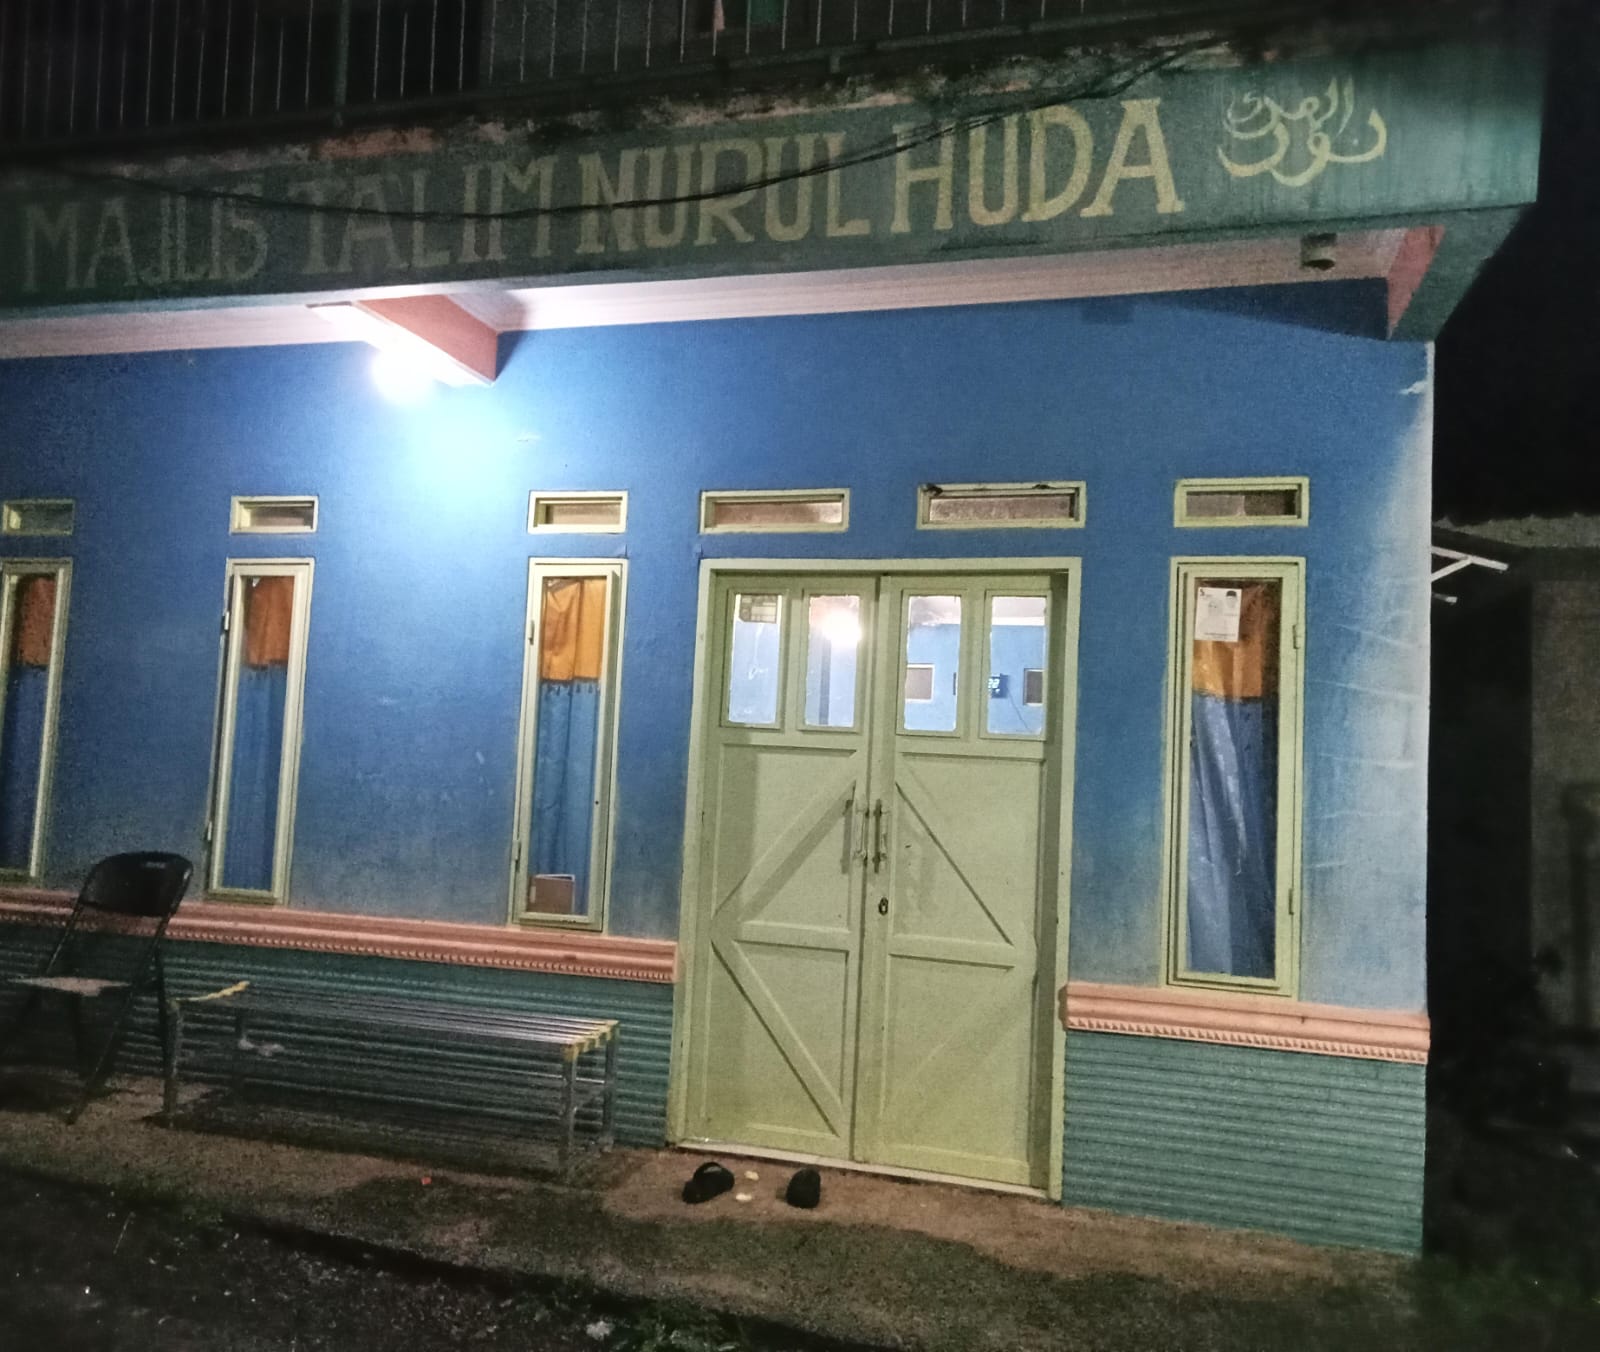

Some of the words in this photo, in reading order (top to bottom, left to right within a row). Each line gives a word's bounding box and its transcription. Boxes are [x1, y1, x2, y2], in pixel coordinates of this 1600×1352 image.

[22, 180, 270, 292] MAJLIS
[575, 130, 872, 256] NURUL
[889, 97, 1186, 235] HUDA
